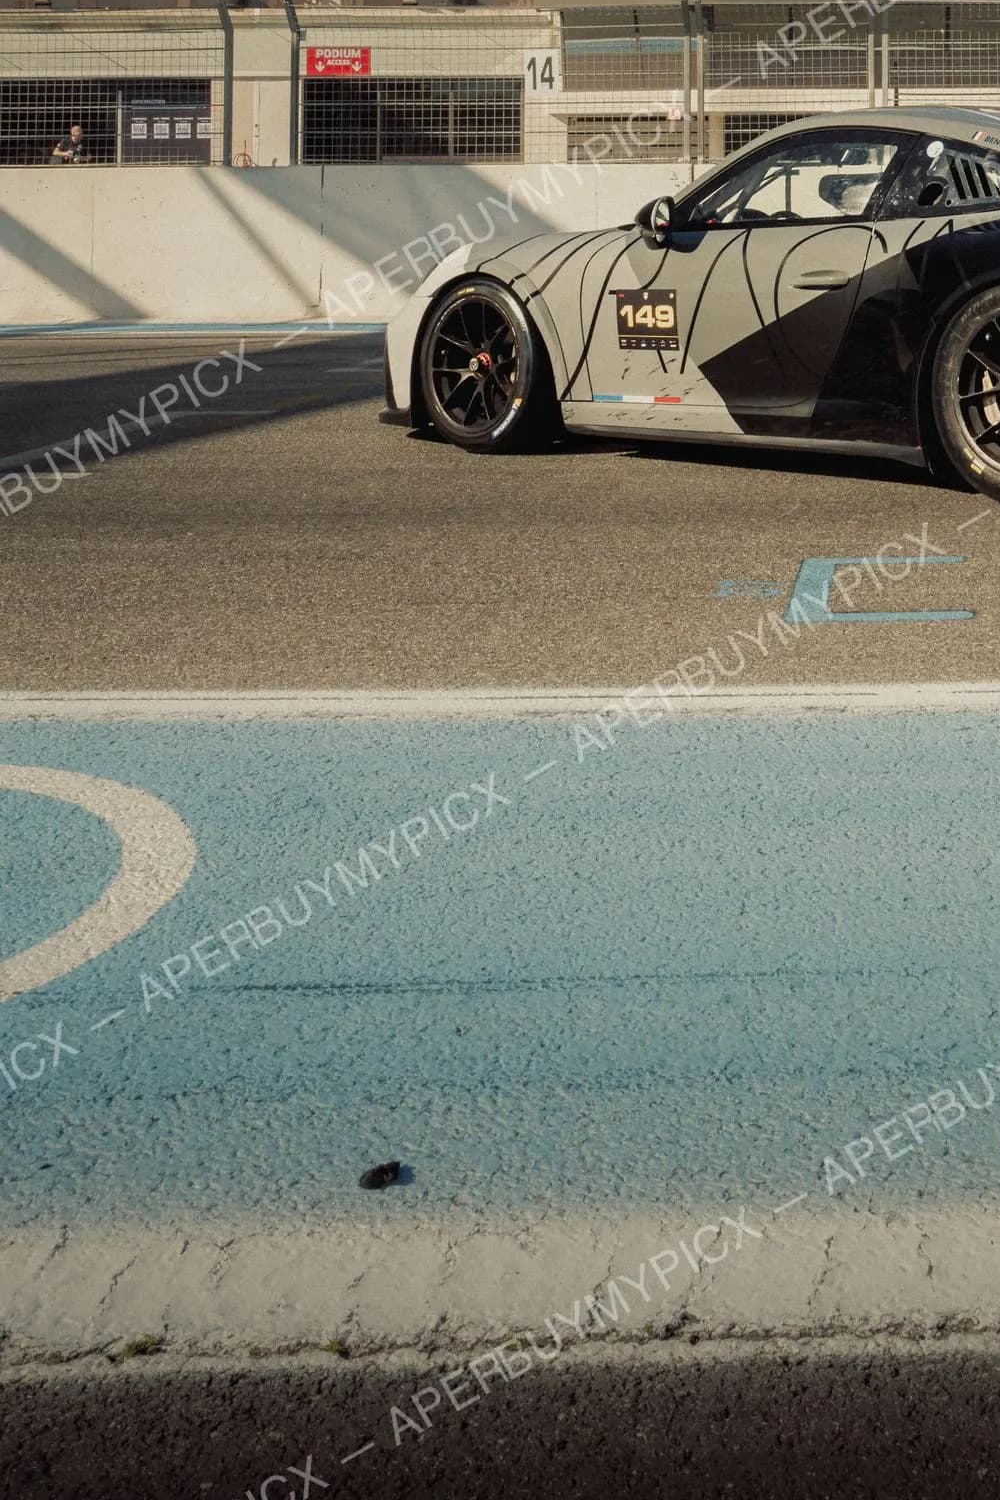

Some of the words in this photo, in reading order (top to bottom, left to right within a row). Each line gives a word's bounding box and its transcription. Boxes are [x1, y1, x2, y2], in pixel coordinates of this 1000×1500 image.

[315, 49, 361, 58] PODIUM
[526, 56, 555, 90] 14
[620, 304, 675, 329] 149
